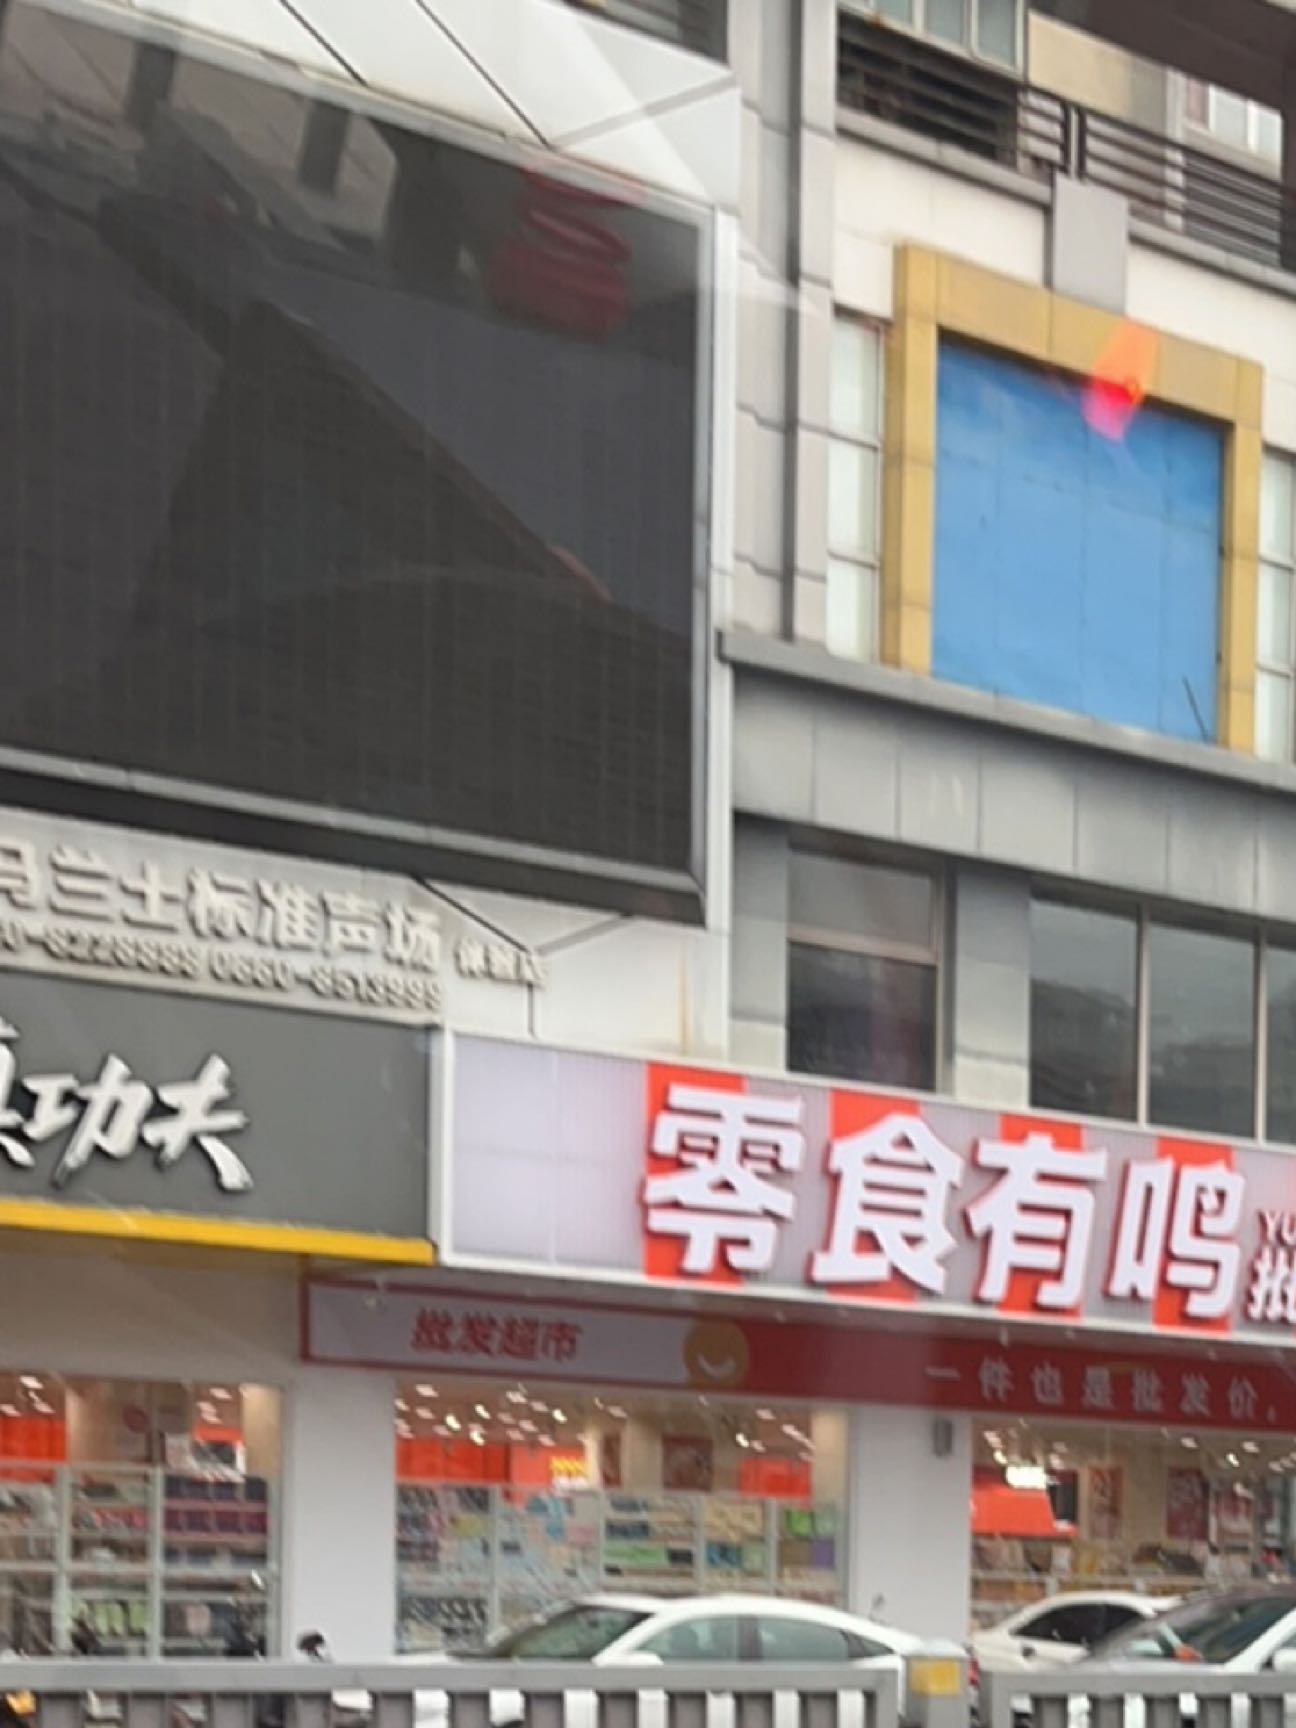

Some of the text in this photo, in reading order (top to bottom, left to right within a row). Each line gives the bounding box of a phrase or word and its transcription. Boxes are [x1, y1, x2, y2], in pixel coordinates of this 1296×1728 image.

[643, 1081, 1248, 1318] 零食有鸣
[410, 1306, 583, 1363] 批发超市
